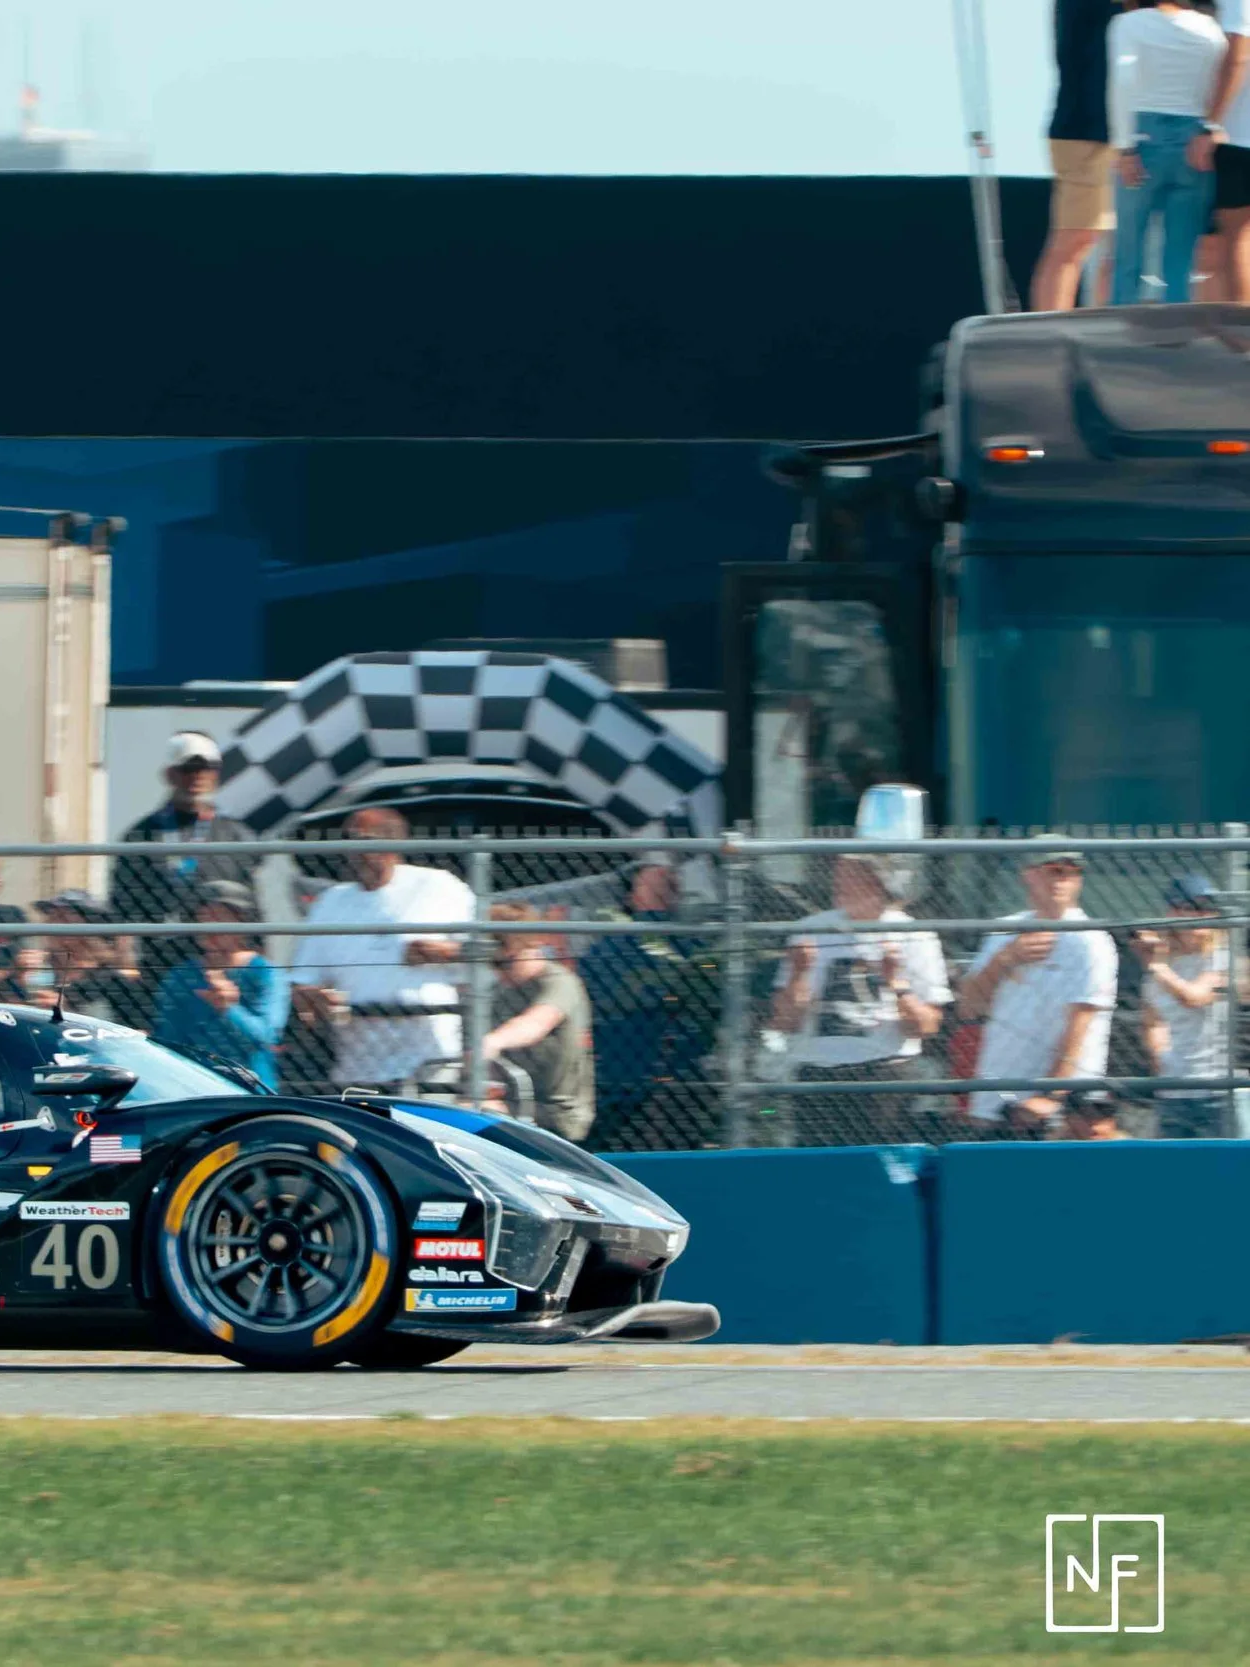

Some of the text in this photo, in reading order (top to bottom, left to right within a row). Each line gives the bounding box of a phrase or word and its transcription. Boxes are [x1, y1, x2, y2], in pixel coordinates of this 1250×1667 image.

[25, 1206, 124, 1216] WeatherTech
[30, 1223, 120, 1290] 40
[417, 1241, 482, 1257] MOTUL
[408, 1265, 485, 1283] dallara
[436, 1296, 508, 1306] MICHELIN
